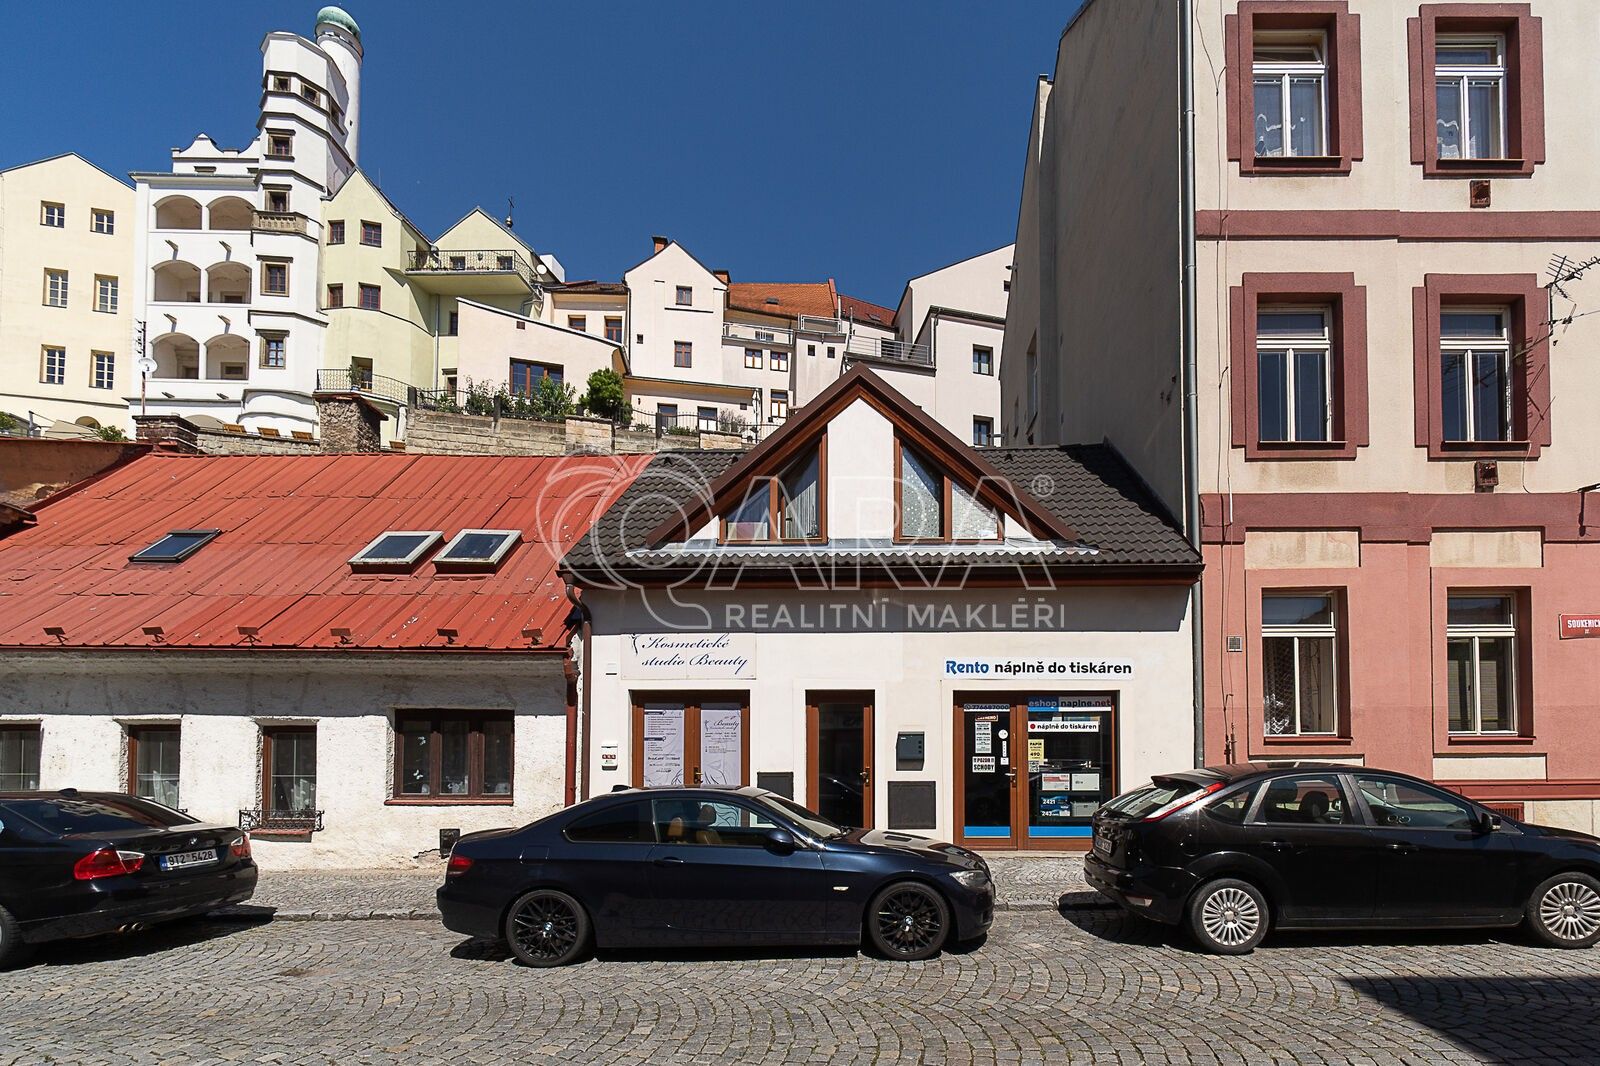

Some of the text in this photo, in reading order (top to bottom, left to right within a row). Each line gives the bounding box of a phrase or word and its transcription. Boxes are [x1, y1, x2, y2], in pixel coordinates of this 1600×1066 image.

[641, 633, 730, 649] Kosmetické
[641, 653, 748, 674] studio Beauty
[946, 661, 1132, 676] Rento náplně do tiskáren
[1028, 698, 1112, 710] eshop naplne.net
[1037, 723, 1059, 731] náplně
[168, 851, 214, 866] 9T2 5428
